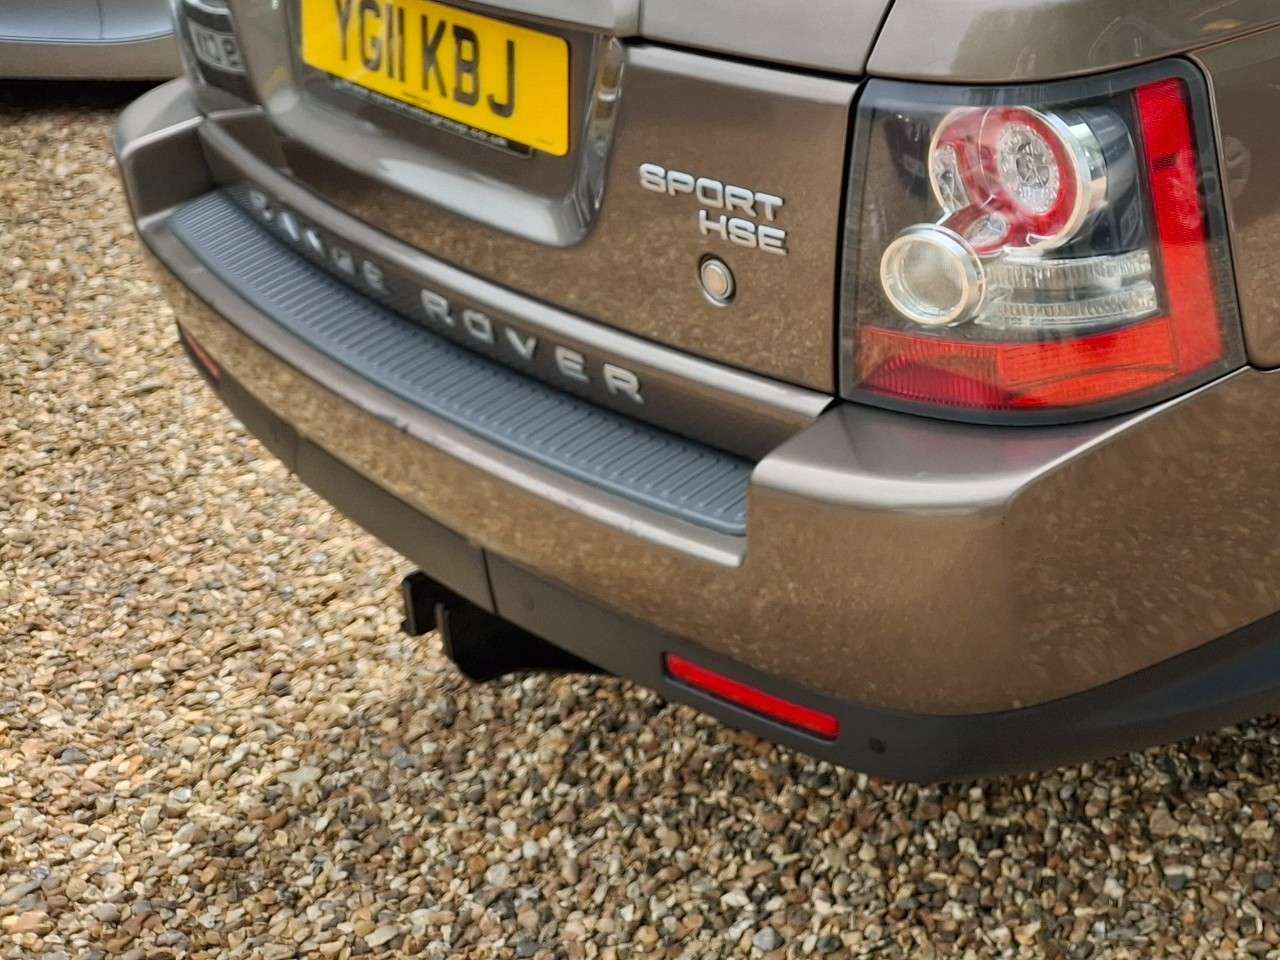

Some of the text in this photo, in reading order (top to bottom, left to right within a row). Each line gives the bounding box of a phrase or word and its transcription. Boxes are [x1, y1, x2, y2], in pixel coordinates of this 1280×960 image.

[420, 13, 516, 119] KBJ
[639, 162, 784, 223] SPORT
[698, 209, 788, 257] HSE
[249, 189, 646, 406] RANGE ROVER
